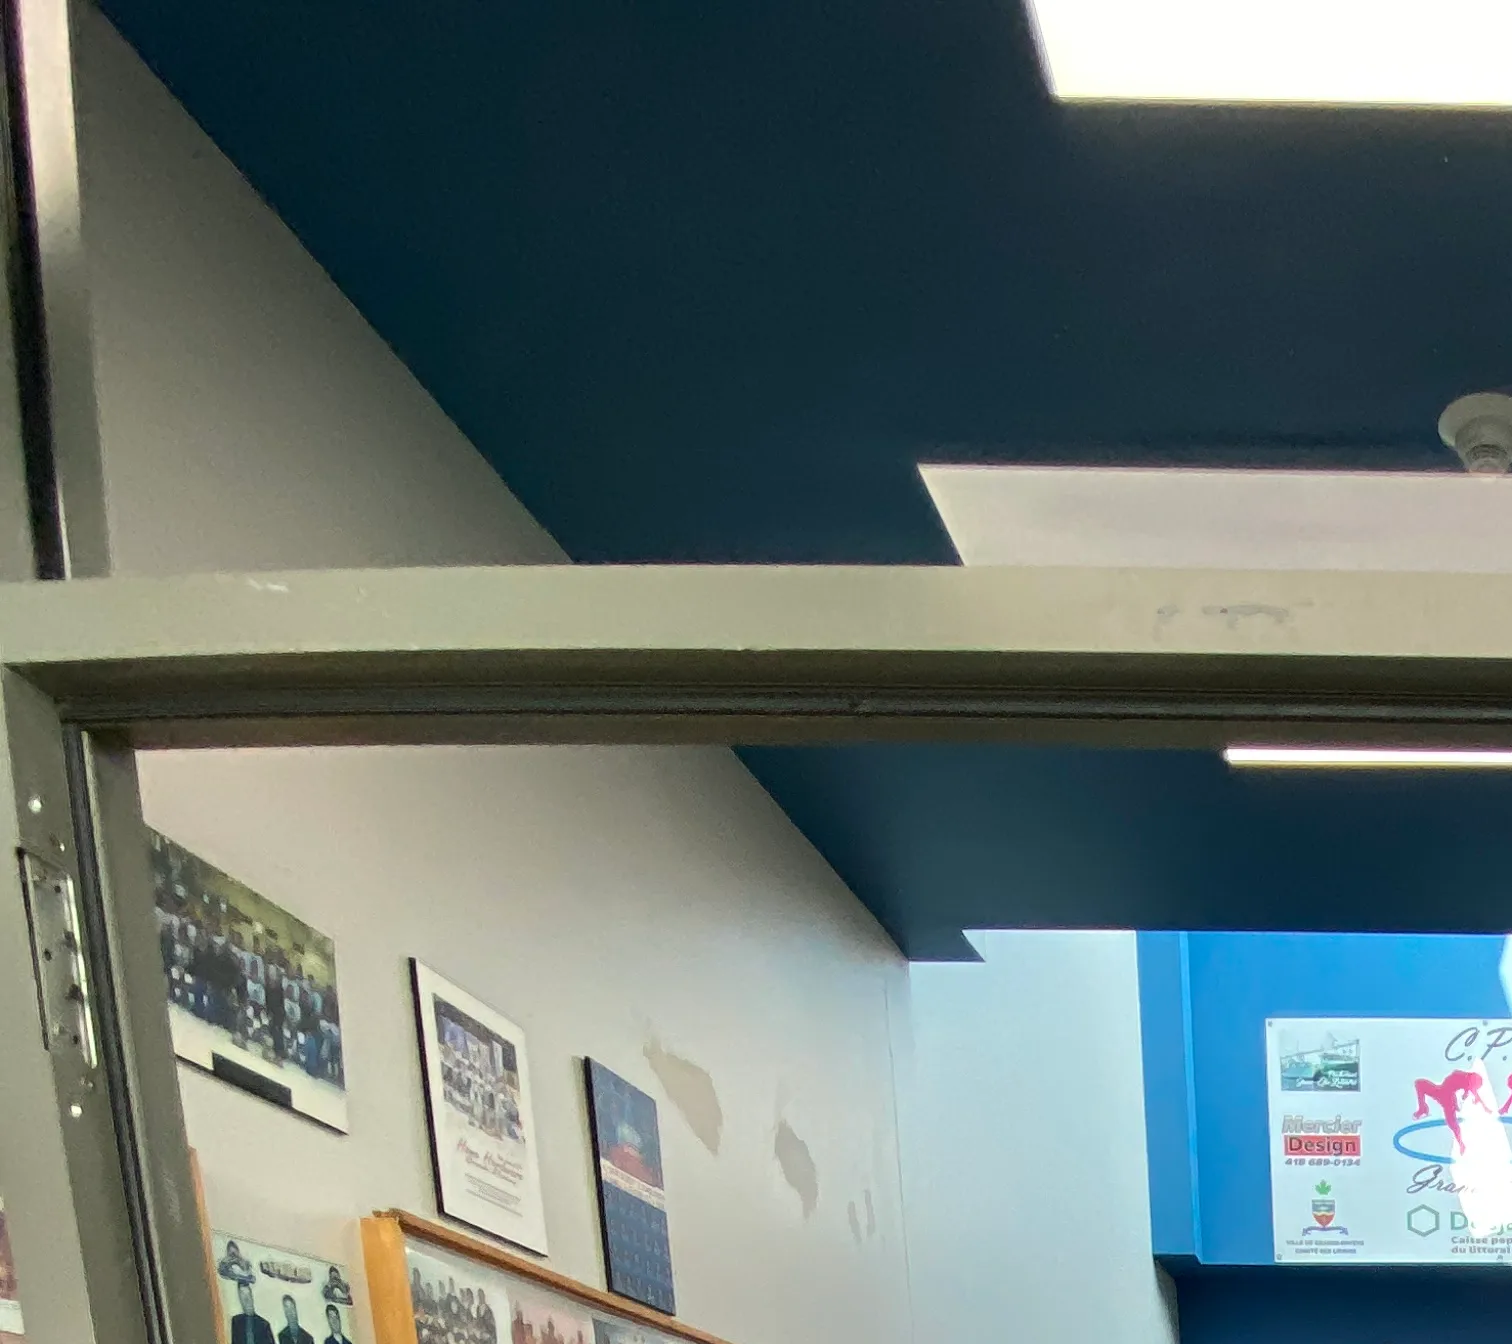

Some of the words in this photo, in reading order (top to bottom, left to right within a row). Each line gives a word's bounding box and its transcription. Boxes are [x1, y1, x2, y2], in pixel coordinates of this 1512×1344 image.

[1282, 1114, 1362, 1133] Mercier
[1289, 1136, 1356, 1156] Design
[1285, 1158, 1306, 1166] 418
[1451, 1235, 1489, 1244] Caisse
[1451, 1245, 1466, 1254] du
[1469, 1245, 1511, 1254] littoral
